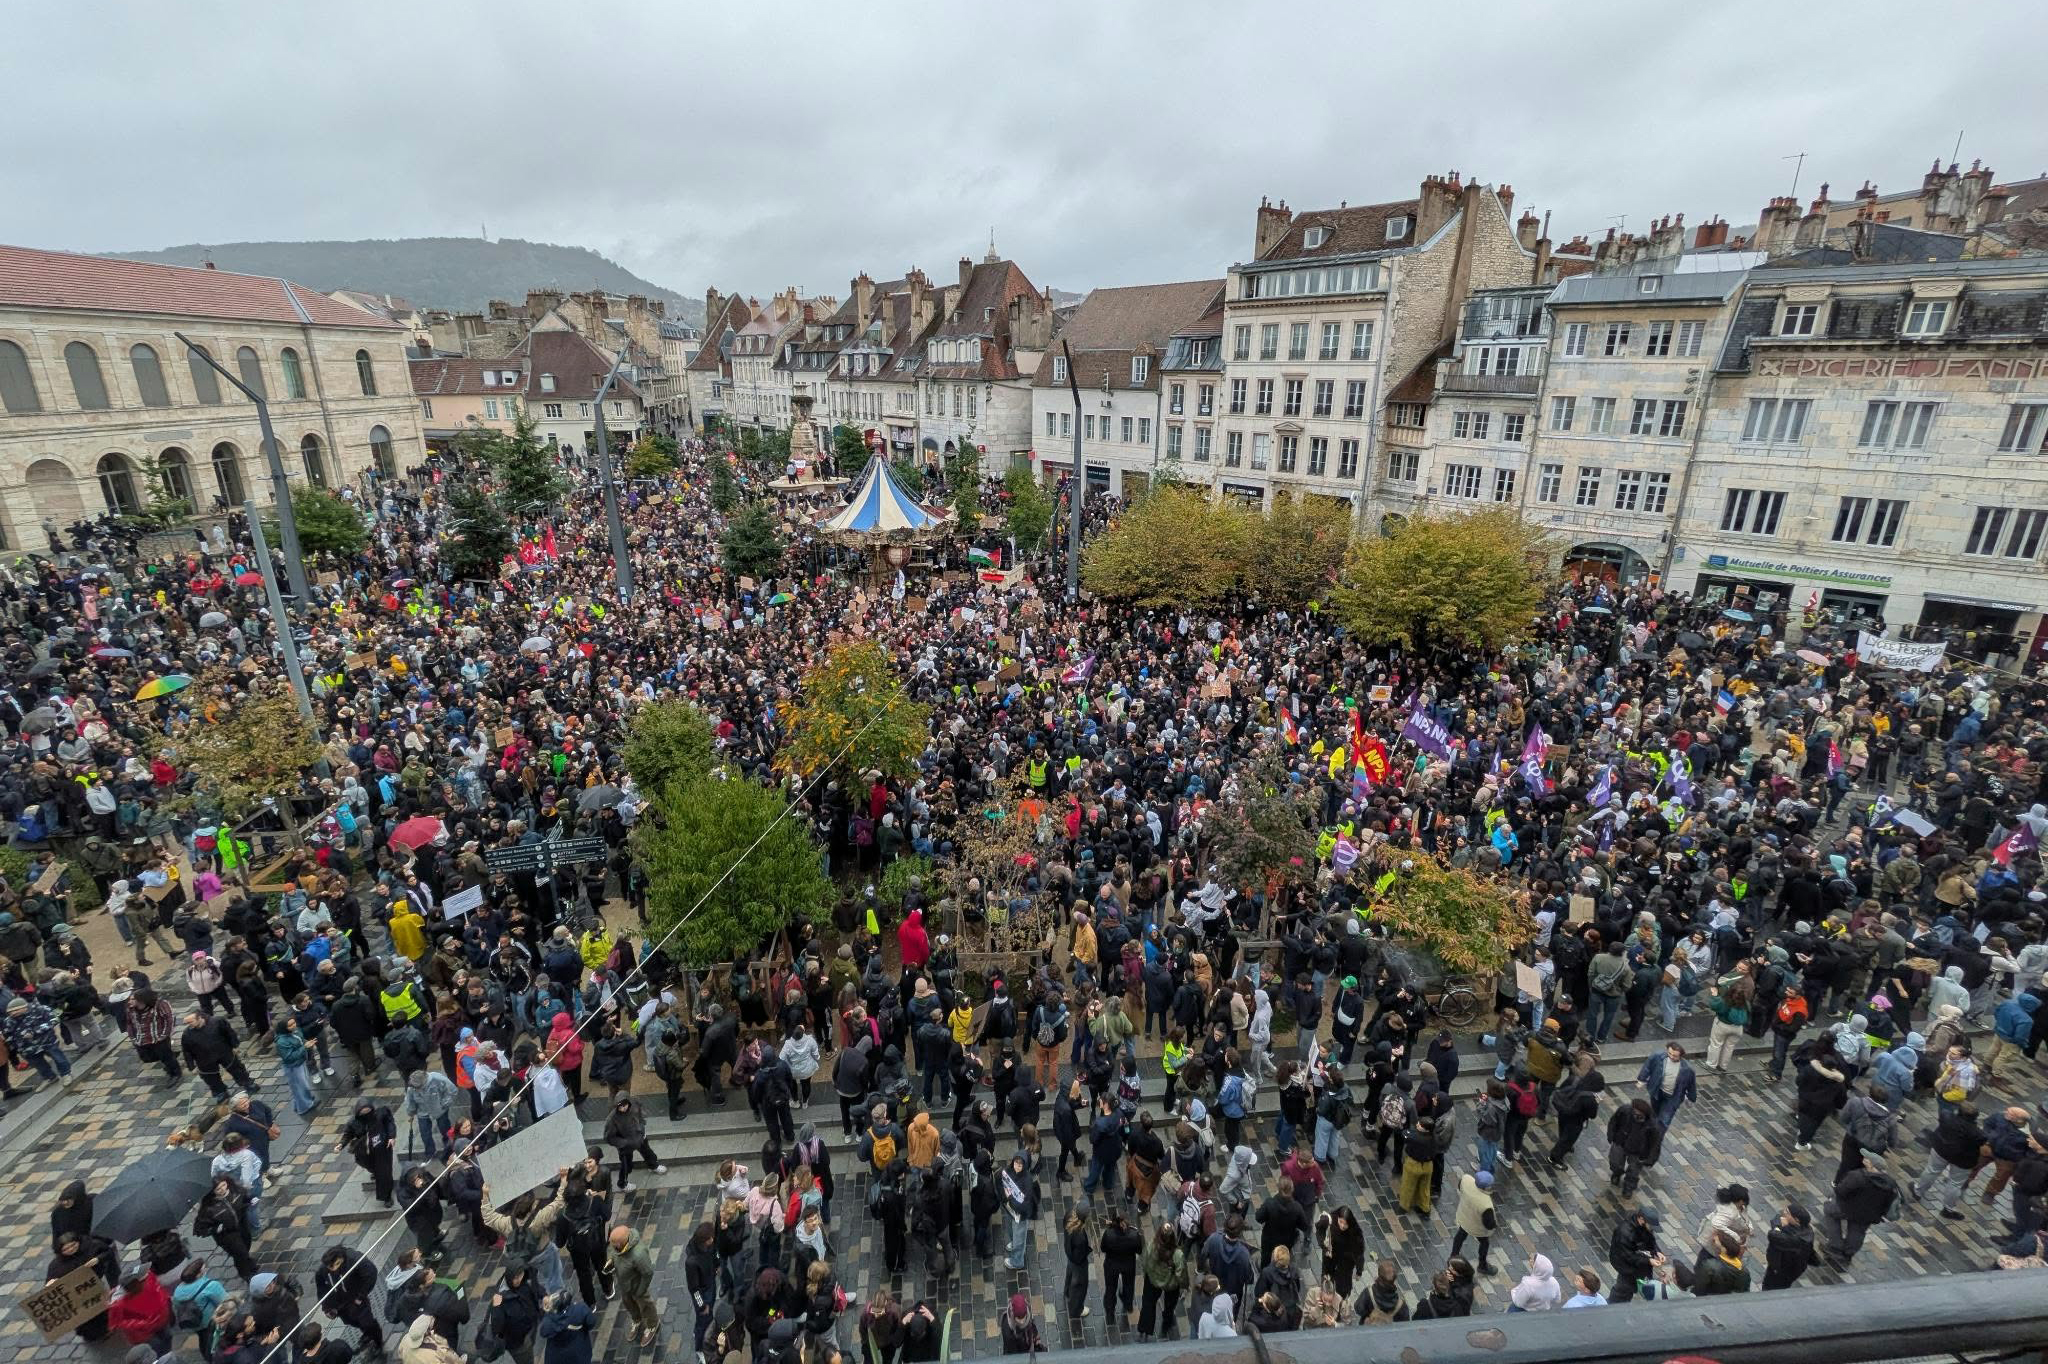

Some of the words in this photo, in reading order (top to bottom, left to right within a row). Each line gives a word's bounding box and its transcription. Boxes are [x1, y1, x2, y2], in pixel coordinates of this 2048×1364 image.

[1730, 558, 1773, 570] Mutuelle
[1775, 563, 1787, 571] de
[1788, 565, 1829, 577] Poitiers
[1830, 569, 1893, 583] Assurances
